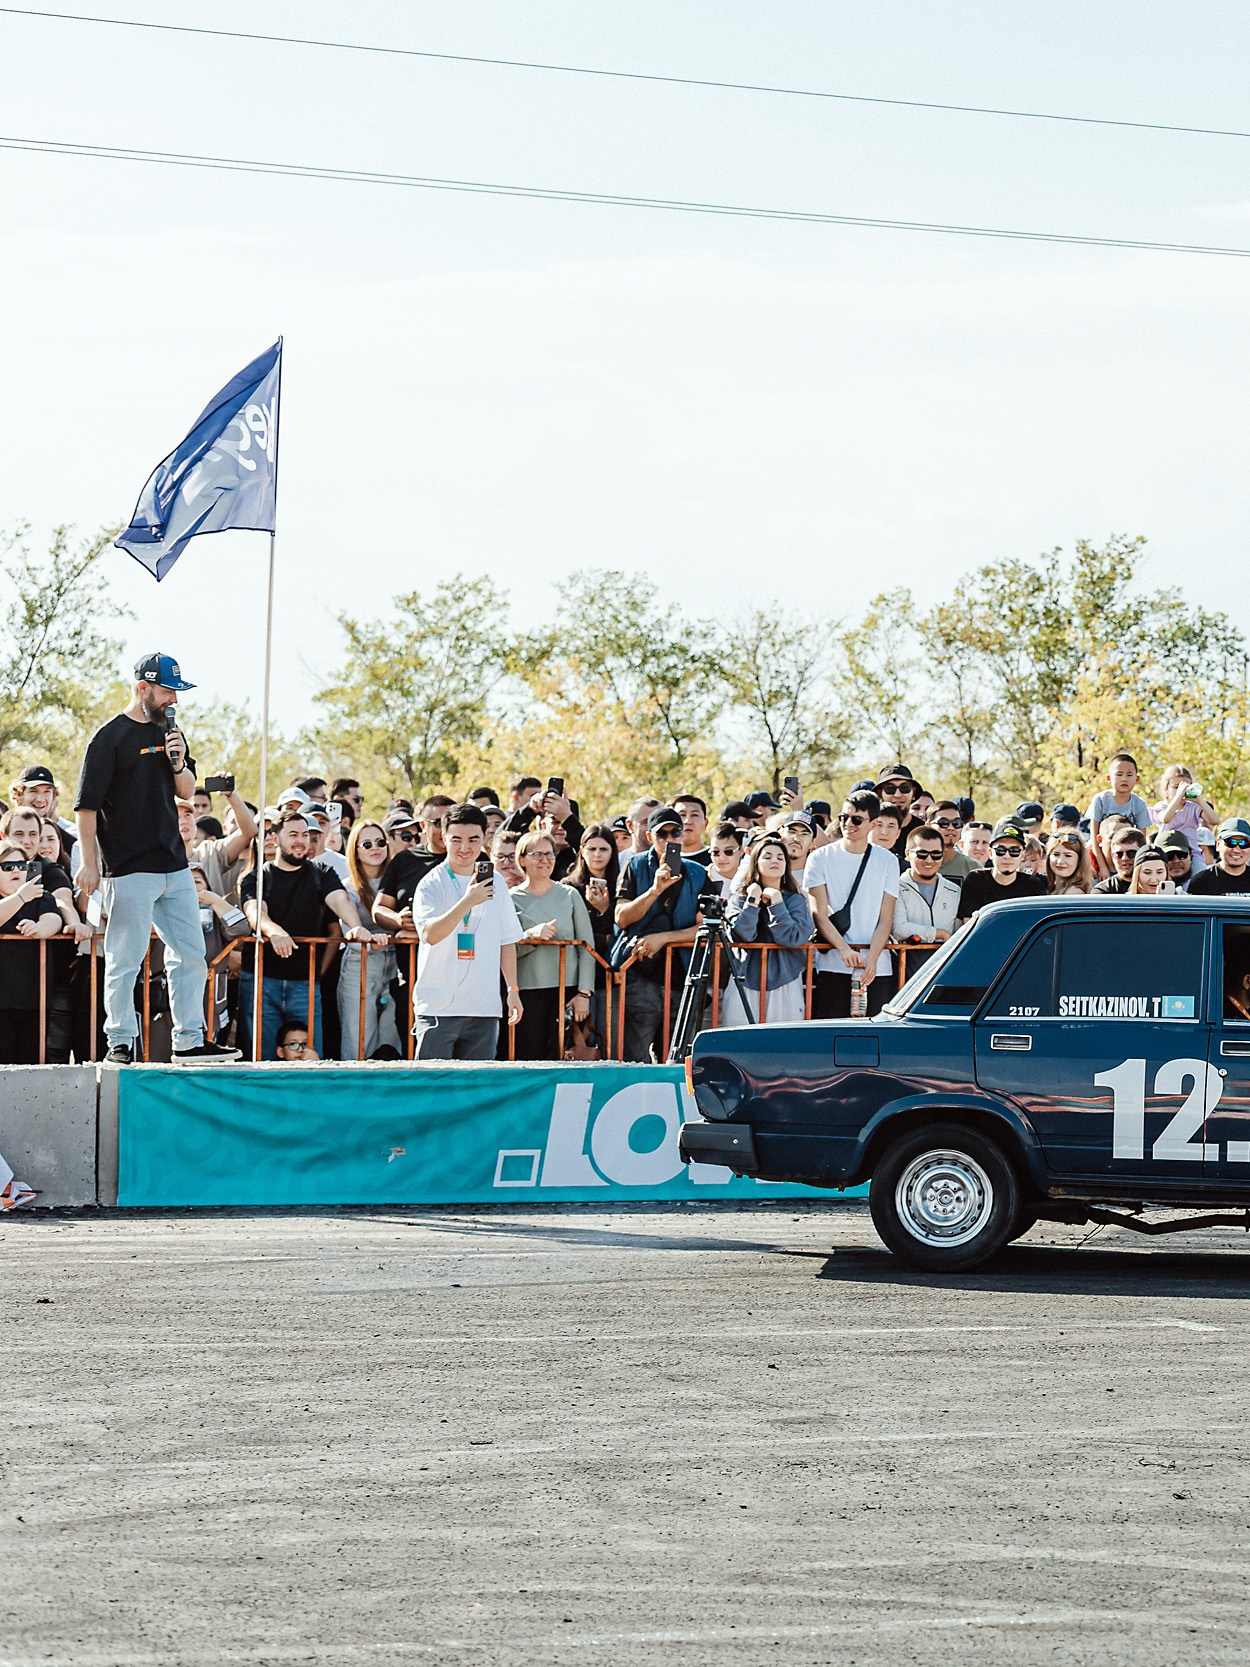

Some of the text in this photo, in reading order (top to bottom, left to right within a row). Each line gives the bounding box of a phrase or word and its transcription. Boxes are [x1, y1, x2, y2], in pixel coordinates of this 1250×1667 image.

[1009, 1006, 1040, 1017] 2107
[1059, 995, 1162, 1018] SEITKAZINOV. T
